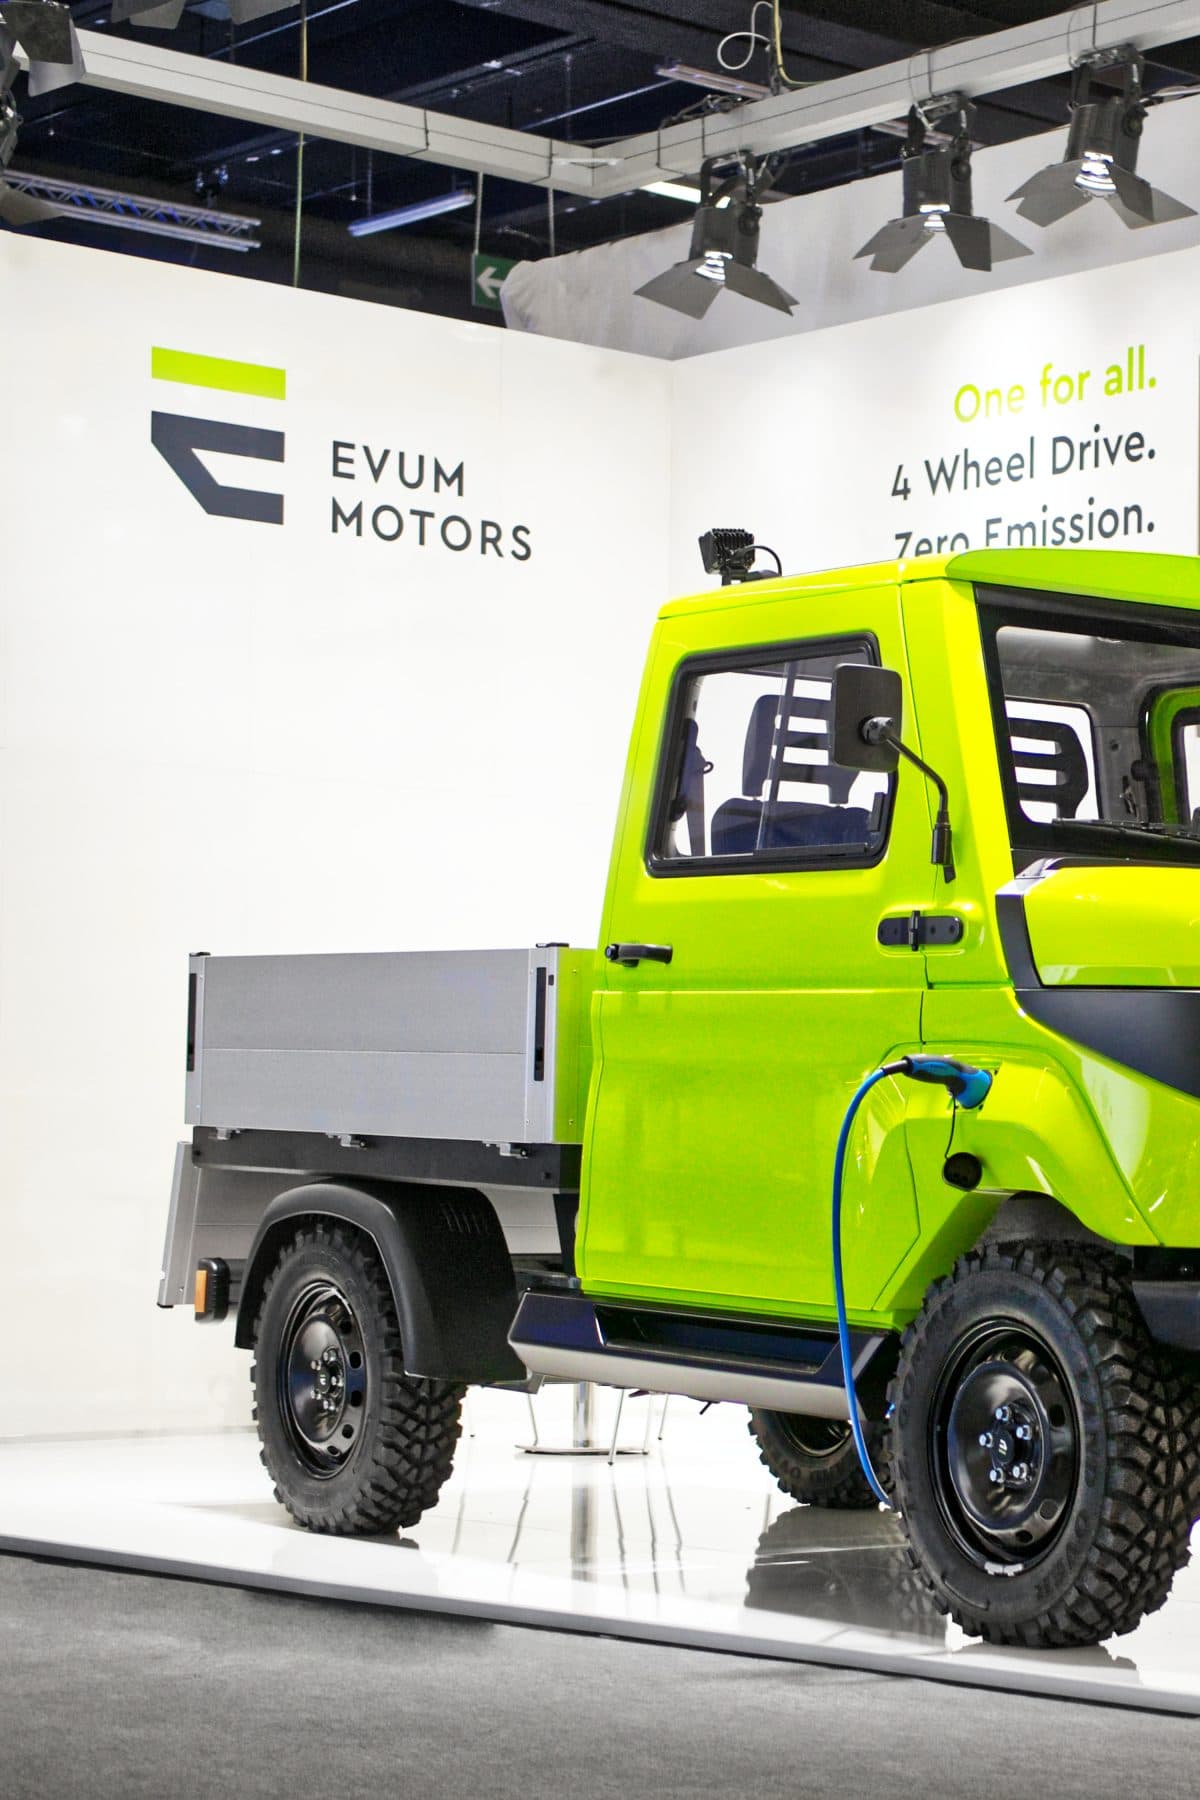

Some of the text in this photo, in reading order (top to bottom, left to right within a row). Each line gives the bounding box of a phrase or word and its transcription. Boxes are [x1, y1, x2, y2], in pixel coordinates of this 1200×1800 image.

[954, 344, 1157, 422] One for all.
[332, 440, 464, 497] EVUM
[891, 423, 1156, 500] 4 Wheel Drive.
[331, 496, 532, 561] MOTORS
[985, 496, 1155, 548] Emission.
